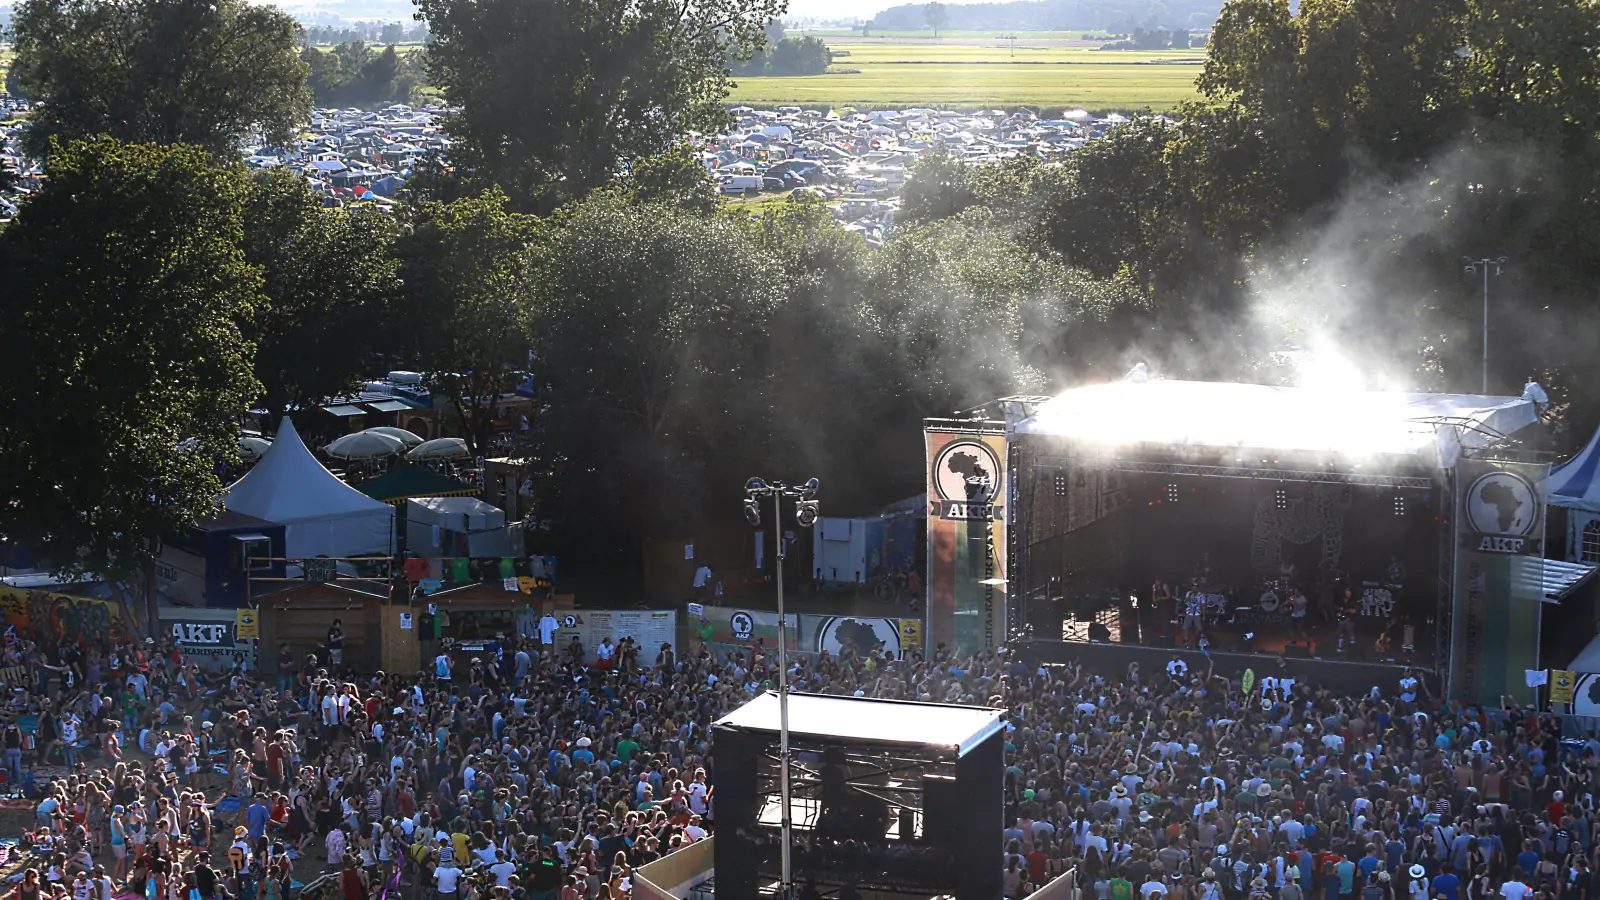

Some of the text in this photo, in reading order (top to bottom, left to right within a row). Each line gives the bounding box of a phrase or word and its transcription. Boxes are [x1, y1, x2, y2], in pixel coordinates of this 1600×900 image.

[947, 503, 988, 519] AKF
[1478, 536, 1524, 553] AKF
[173, 623, 227, 643] AKF
